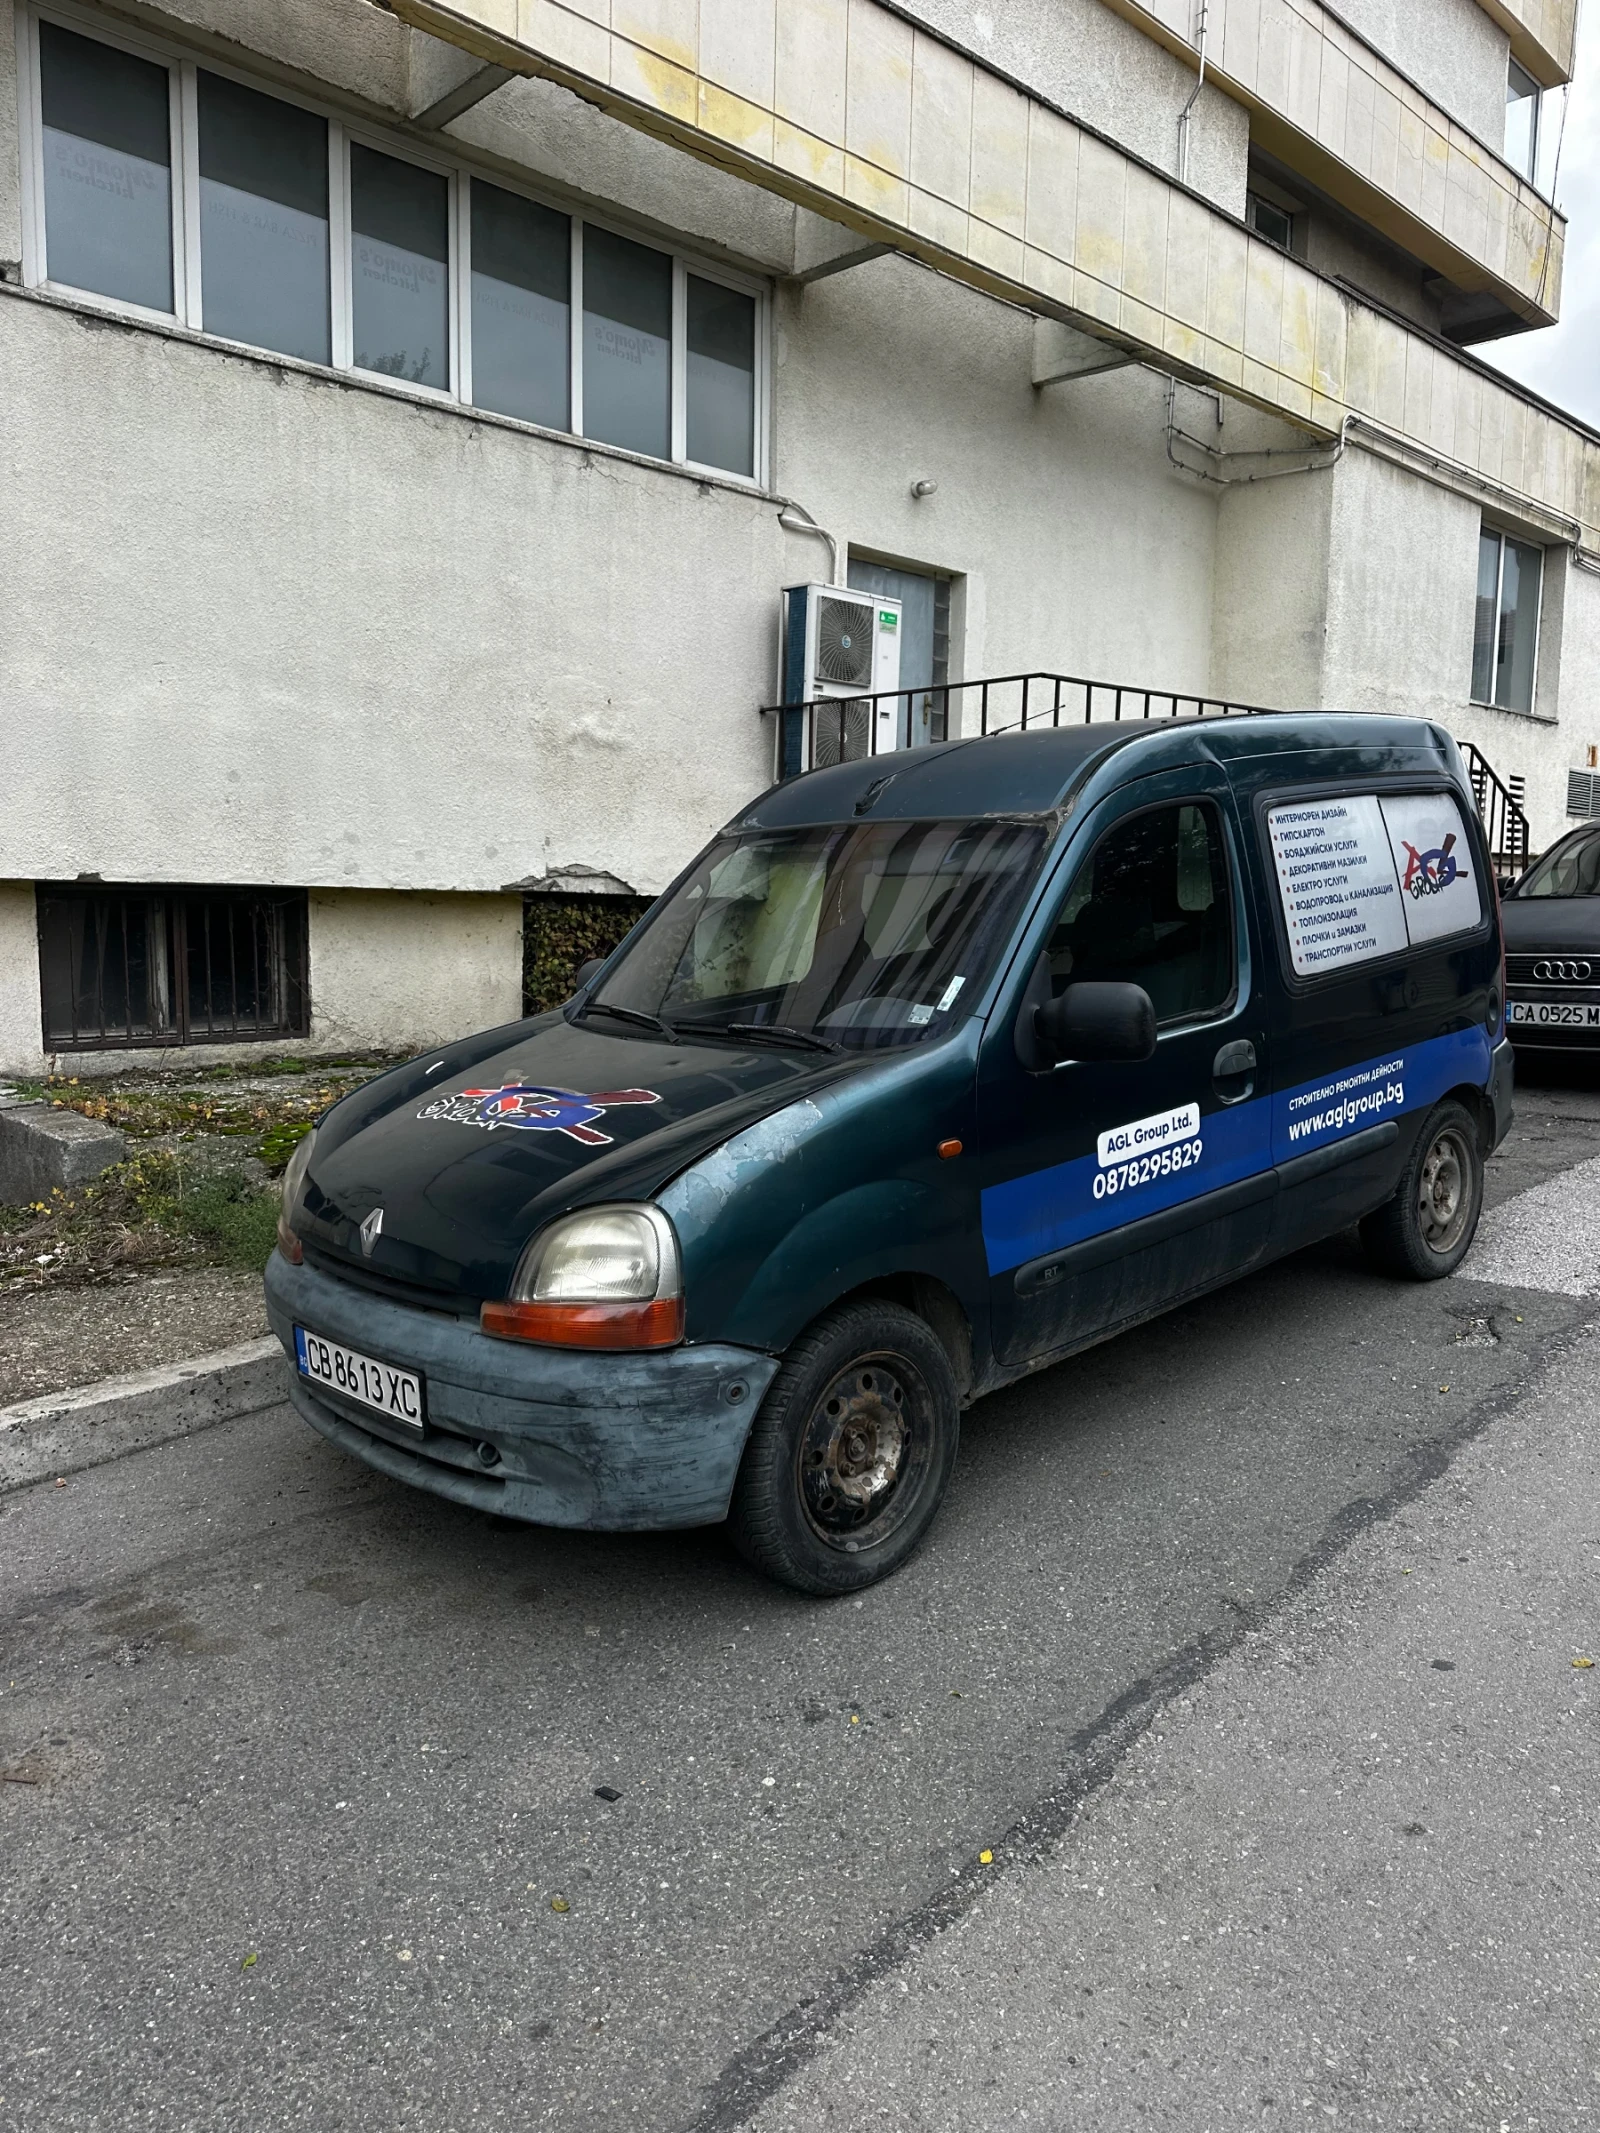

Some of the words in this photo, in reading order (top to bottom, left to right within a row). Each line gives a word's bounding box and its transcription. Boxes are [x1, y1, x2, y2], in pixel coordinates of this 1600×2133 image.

[1275, 811, 1320, 824] ИНТЕРИОРЕН
[1321, 806, 1347, 820] ДИЗАЙН
[1280, 827, 1325, 841] ГИПСКАРТОН
[1284, 843, 1333, 859] БОЯДЖИЙСКИ
[1333, 840, 1358, 851] УСЛУГИ
[1289, 860, 1336, 877] ДЕКОРАТИВНИ
[1337, 855, 1367, 868] МАЗИЛКИ
[1292, 880, 1323, 893] ЕЛЕКТРО
[1323, 875, 1348, 887] УСЛУГИ
[1296, 893, 1344, 910] ВОДОПРОВОД
[1349, 884, 1393, 900] КАНАЛИЗАЦИЯ
[1299, 908, 1358, 928] ТОПЛОИЗОЛАЦИЯ
[1302, 931, 1330, 945] ПЛОЧКИ
[1336, 923, 1366, 937] ЗАМАЗКИ
[1305, 943, 1353, 962] ТРАНСПОРТНИ
[1353, 937, 1376, 951] УСЛУГИ
[1540, 1006, 1583, 1024] 0525
[1289, 1085, 1335, 1111] СТРОИТЕЛНО
[1336, 1071, 1370, 1094] РЕМОНТНИ
[1371, 1059, 1404, 1082] ДЕЙНОСТИ
[1288, 1082, 1404, 1141] www.aglgroup.bg
[1107, 1132, 1132, 1154] AGL
[1134, 1123, 1170, 1144] Group
[1172, 1112, 1192, 1132] Ltd.
[1093, 1139, 1203, 1199] 0878295829
[1044, 1265, 1059, 1279] RT
[307, 1338, 332, 1380] CB
[334, 1350, 384, 1403] 8613
[386, 1370, 418, 1418] XC
